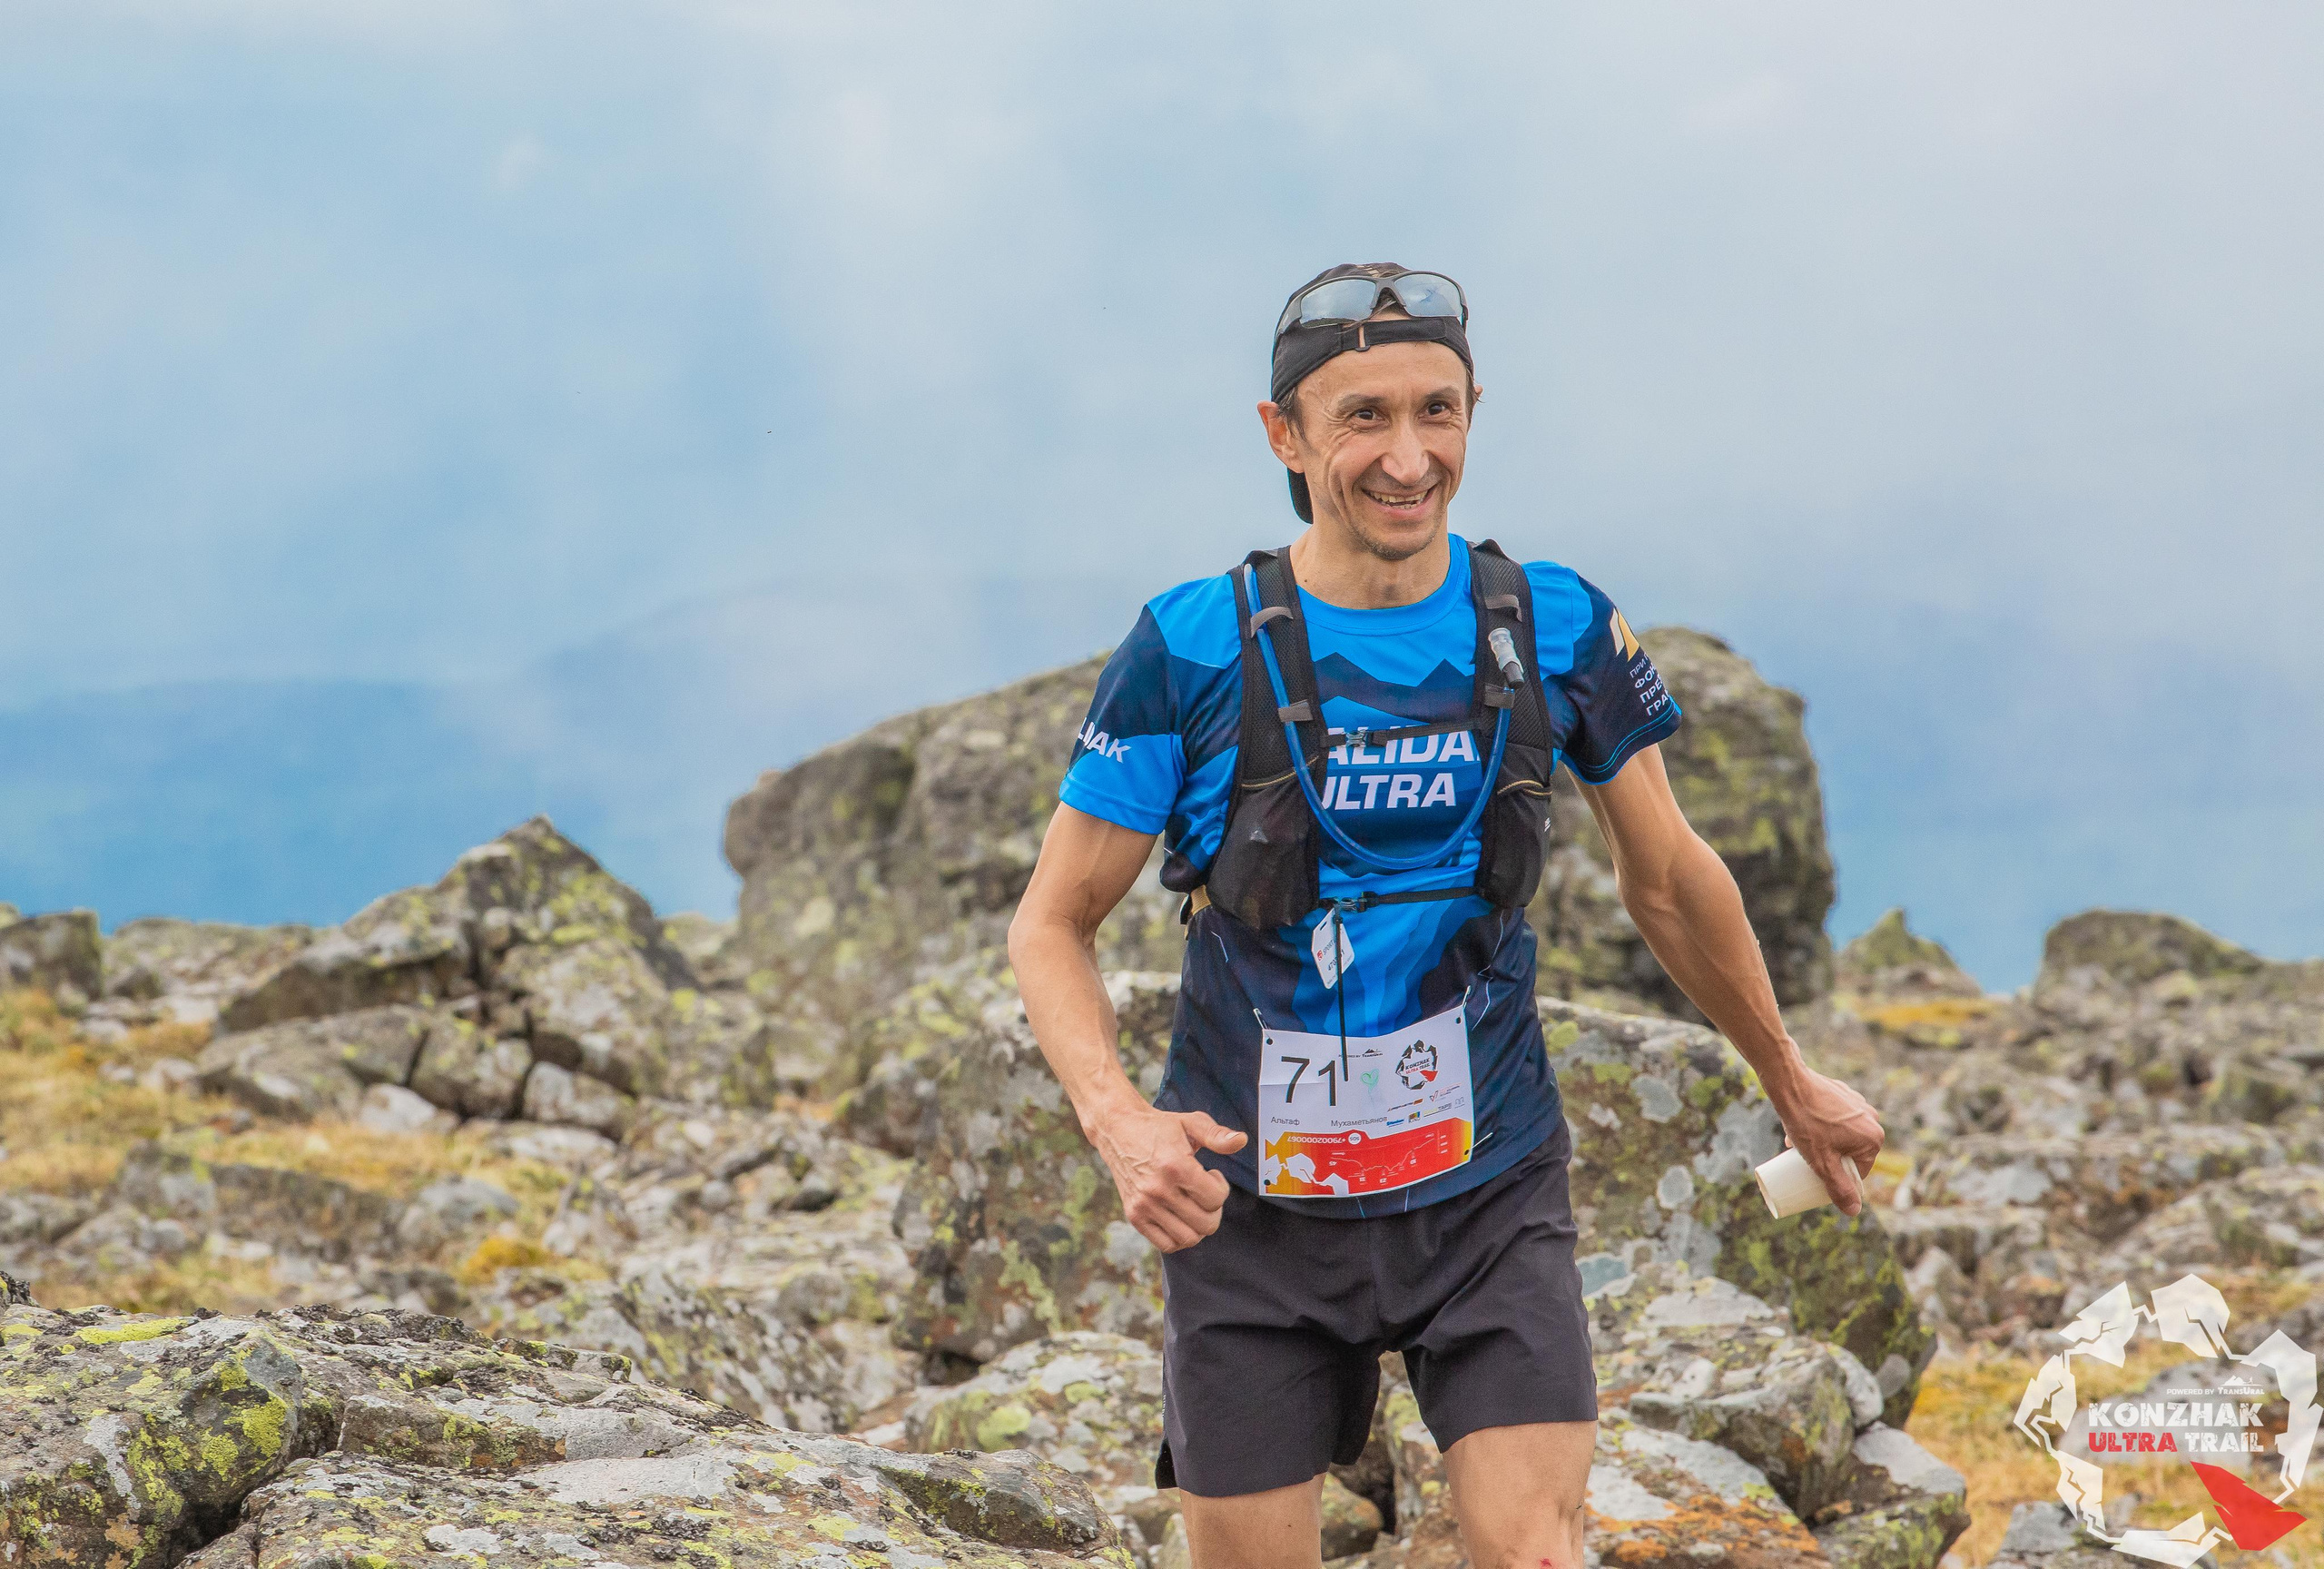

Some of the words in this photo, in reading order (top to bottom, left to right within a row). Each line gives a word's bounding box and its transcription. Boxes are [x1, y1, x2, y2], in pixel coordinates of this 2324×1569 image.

[1281, 1055, 1337, 1107] 71
[1270, 1116, 1300, 1126] Альтаф
[1331, 1115, 1388, 1128] Мухаметьянов
